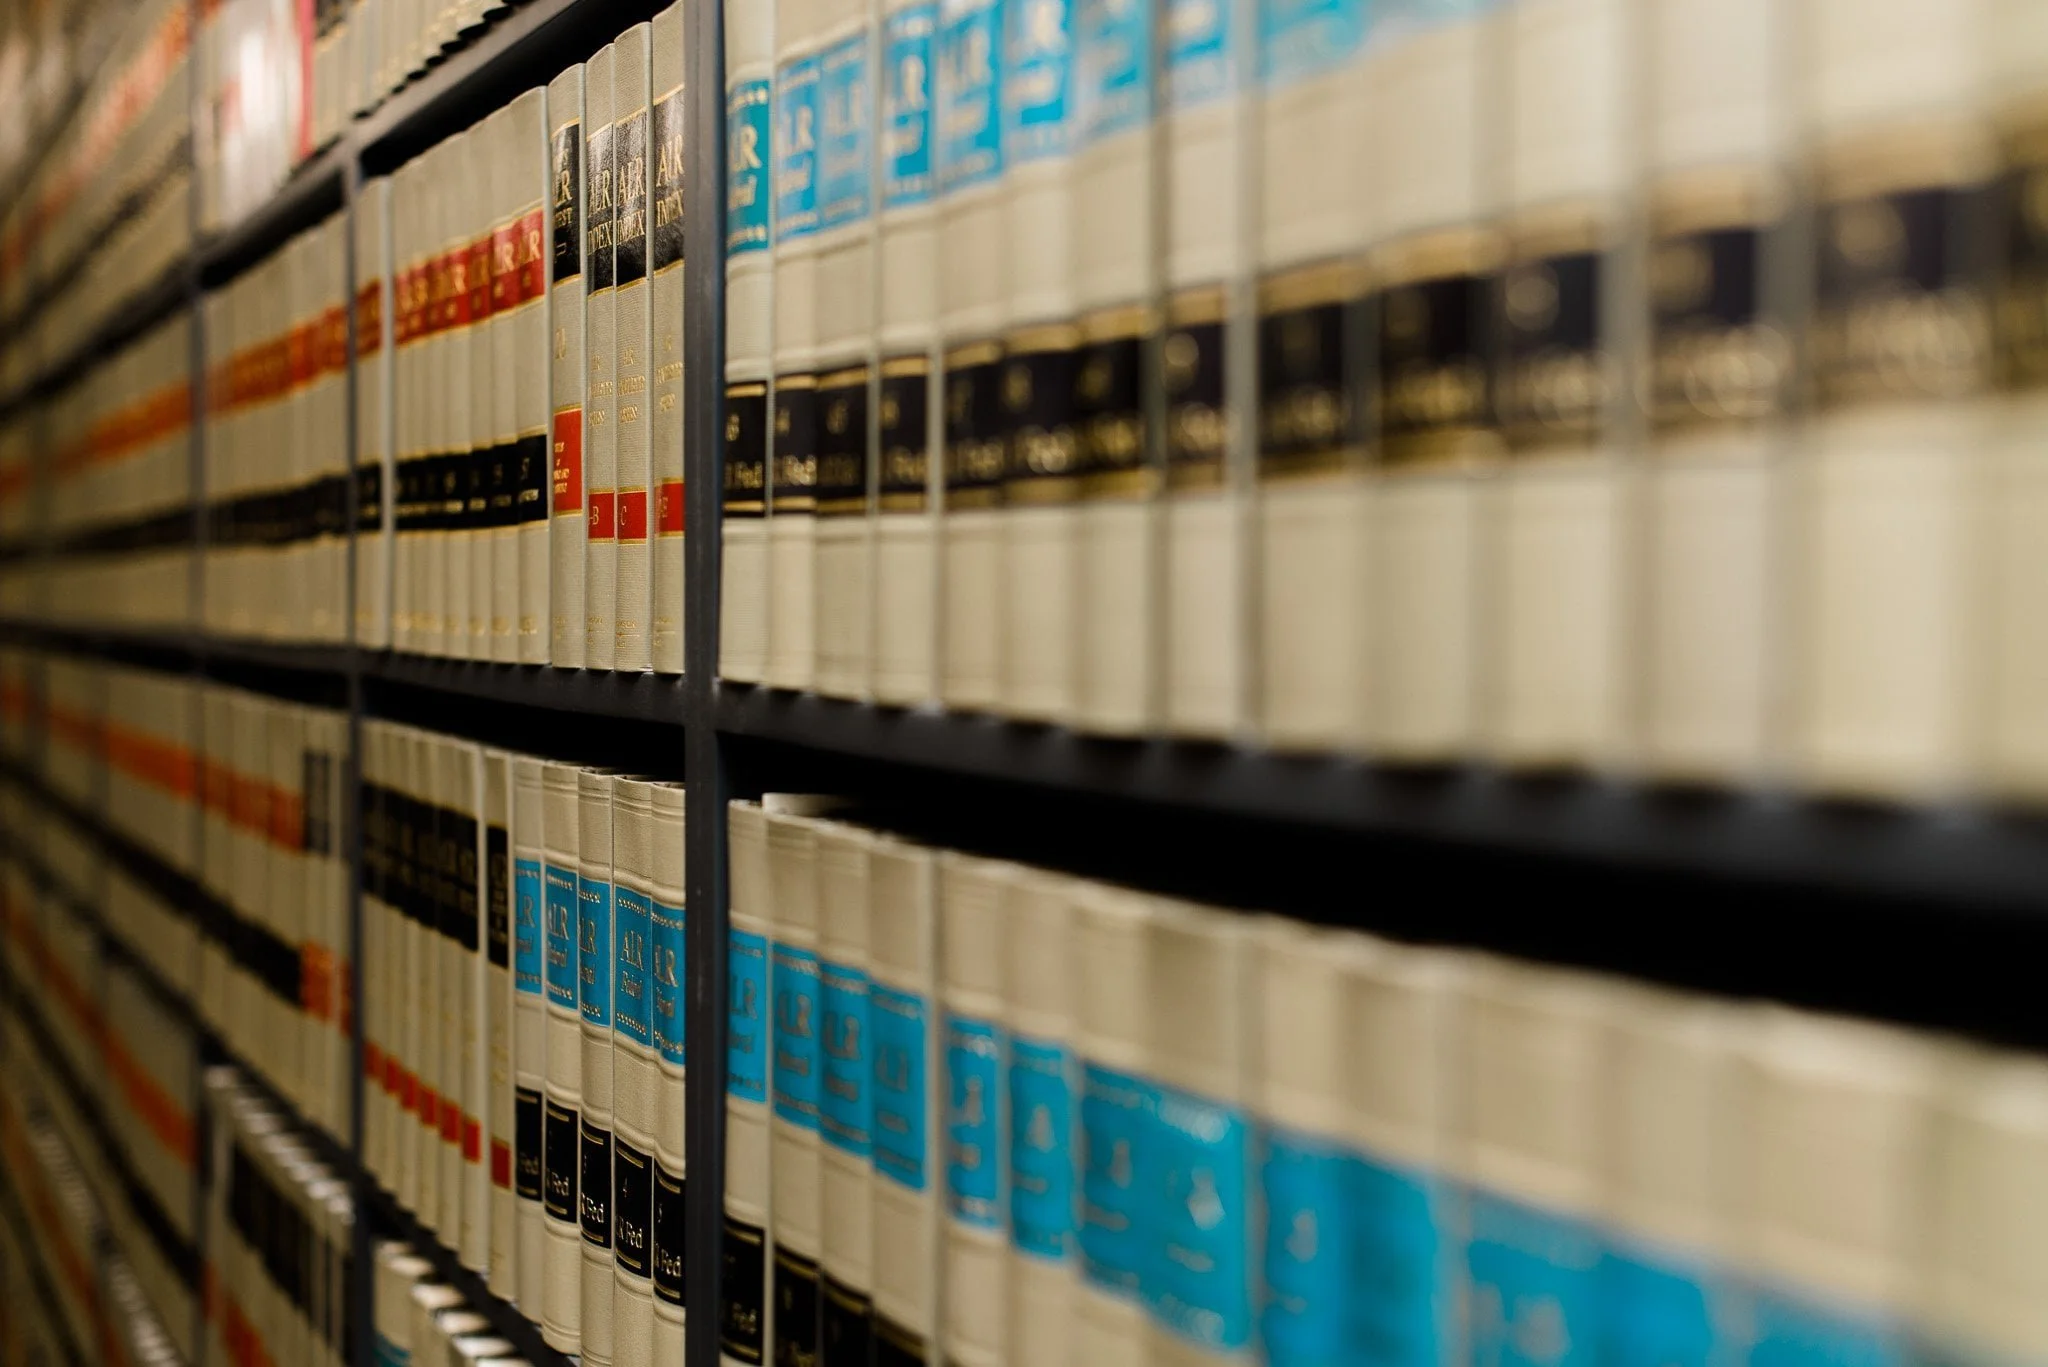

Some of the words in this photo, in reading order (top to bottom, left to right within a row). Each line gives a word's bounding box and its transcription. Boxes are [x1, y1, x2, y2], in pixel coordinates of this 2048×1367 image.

[620, 505, 628, 525] C
[619, 929, 645, 972] ALR
[625, 1220, 643, 1250] Fed
[660, 1247, 682, 1279] Fed
